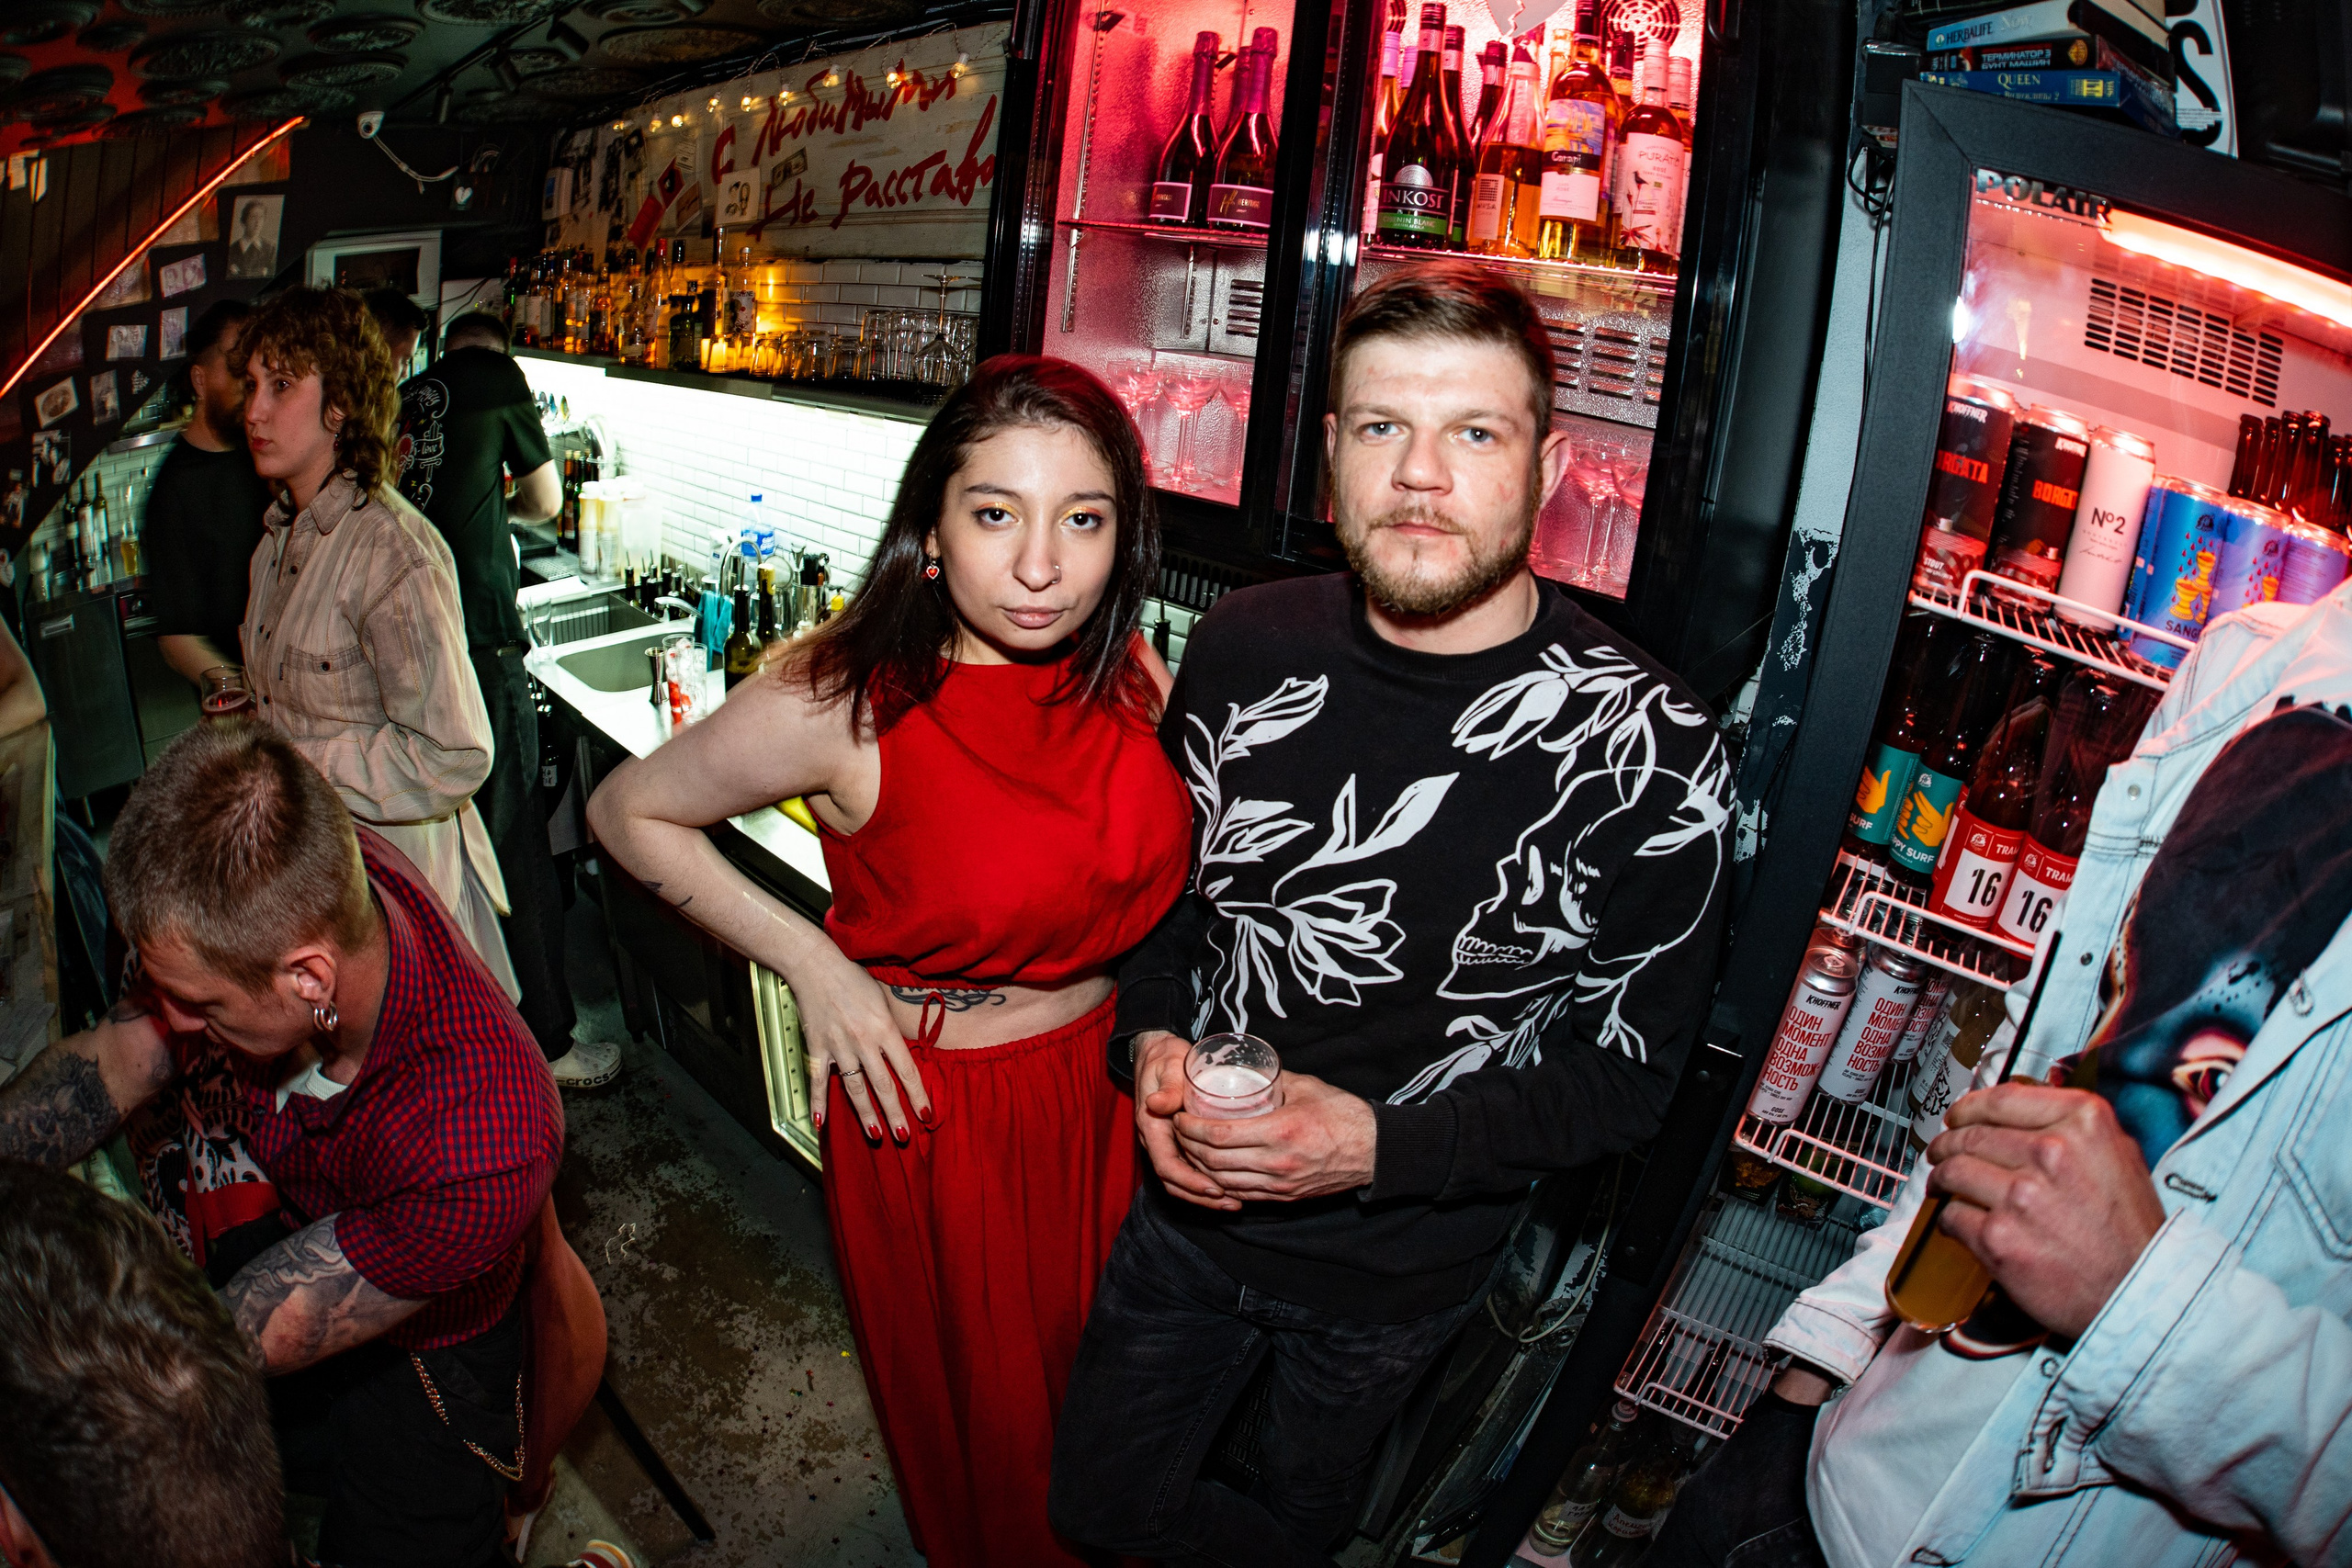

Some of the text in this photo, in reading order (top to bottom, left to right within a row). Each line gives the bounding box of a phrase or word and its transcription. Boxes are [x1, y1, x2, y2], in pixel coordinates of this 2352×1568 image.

[1946, 23, 1994, 44] HERBALIFE
[1981, 49, 2052, 62] ТЕРМИНАТОР 3
[1981, 59, 2051, 70] БУНТ МАШИН
[1997, 73, 2041, 90] QUEEN
[2169, 20, 2222, 146] S
[1976, 168, 2112, 223] POLAIR
[1923, 557, 1945, 570] STOUT
[1905, 847, 1935, 863] SURF
[1968, 868, 2002, 907] 16
[2017, 890, 2053, 933] 16
[1874, 997, 1907, 1017] ОДИН
[1788, 1006, 1824, 1032] ОДИН
[1781, 1023, 1832, 1048] МОМЕНТ
[1860, 1026, 1892, 1045] ОДНА
[1775, 1037, 1808, 1062] ОДНА
[1769, 1053, 1820, 1077] ВОЗМОЖ-
[1847, 1054, 1880, 1073] НОСТЬ
[566, 1073, 610, 1086] crocs
[1763, 1066, 1799, 1091] НОСТЬ
